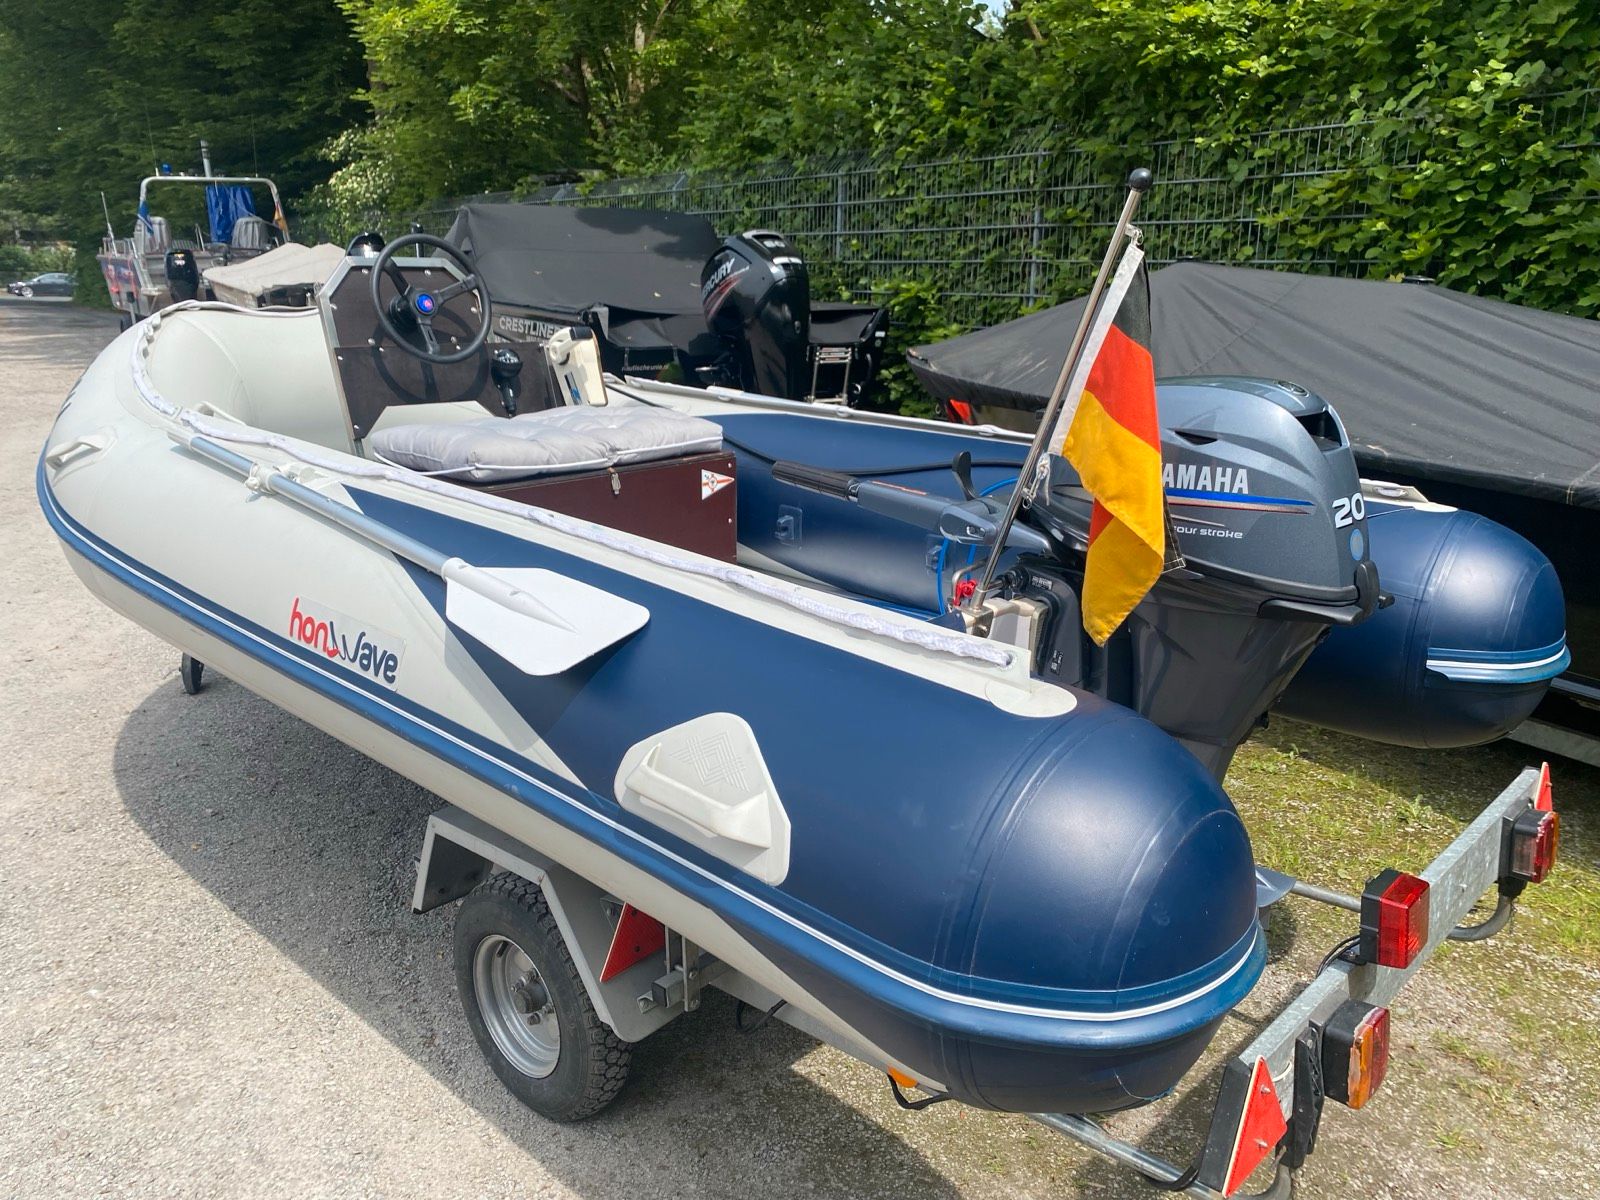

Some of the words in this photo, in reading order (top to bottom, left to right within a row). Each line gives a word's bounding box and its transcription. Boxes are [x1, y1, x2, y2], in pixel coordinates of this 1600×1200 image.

[702, 257, 736, 298] ERCURY
[1162, 463, 1249, 495] AMAHA
[1332, 493, 1365, 529] 20
[1199, 526, 1243, 539] stroke
